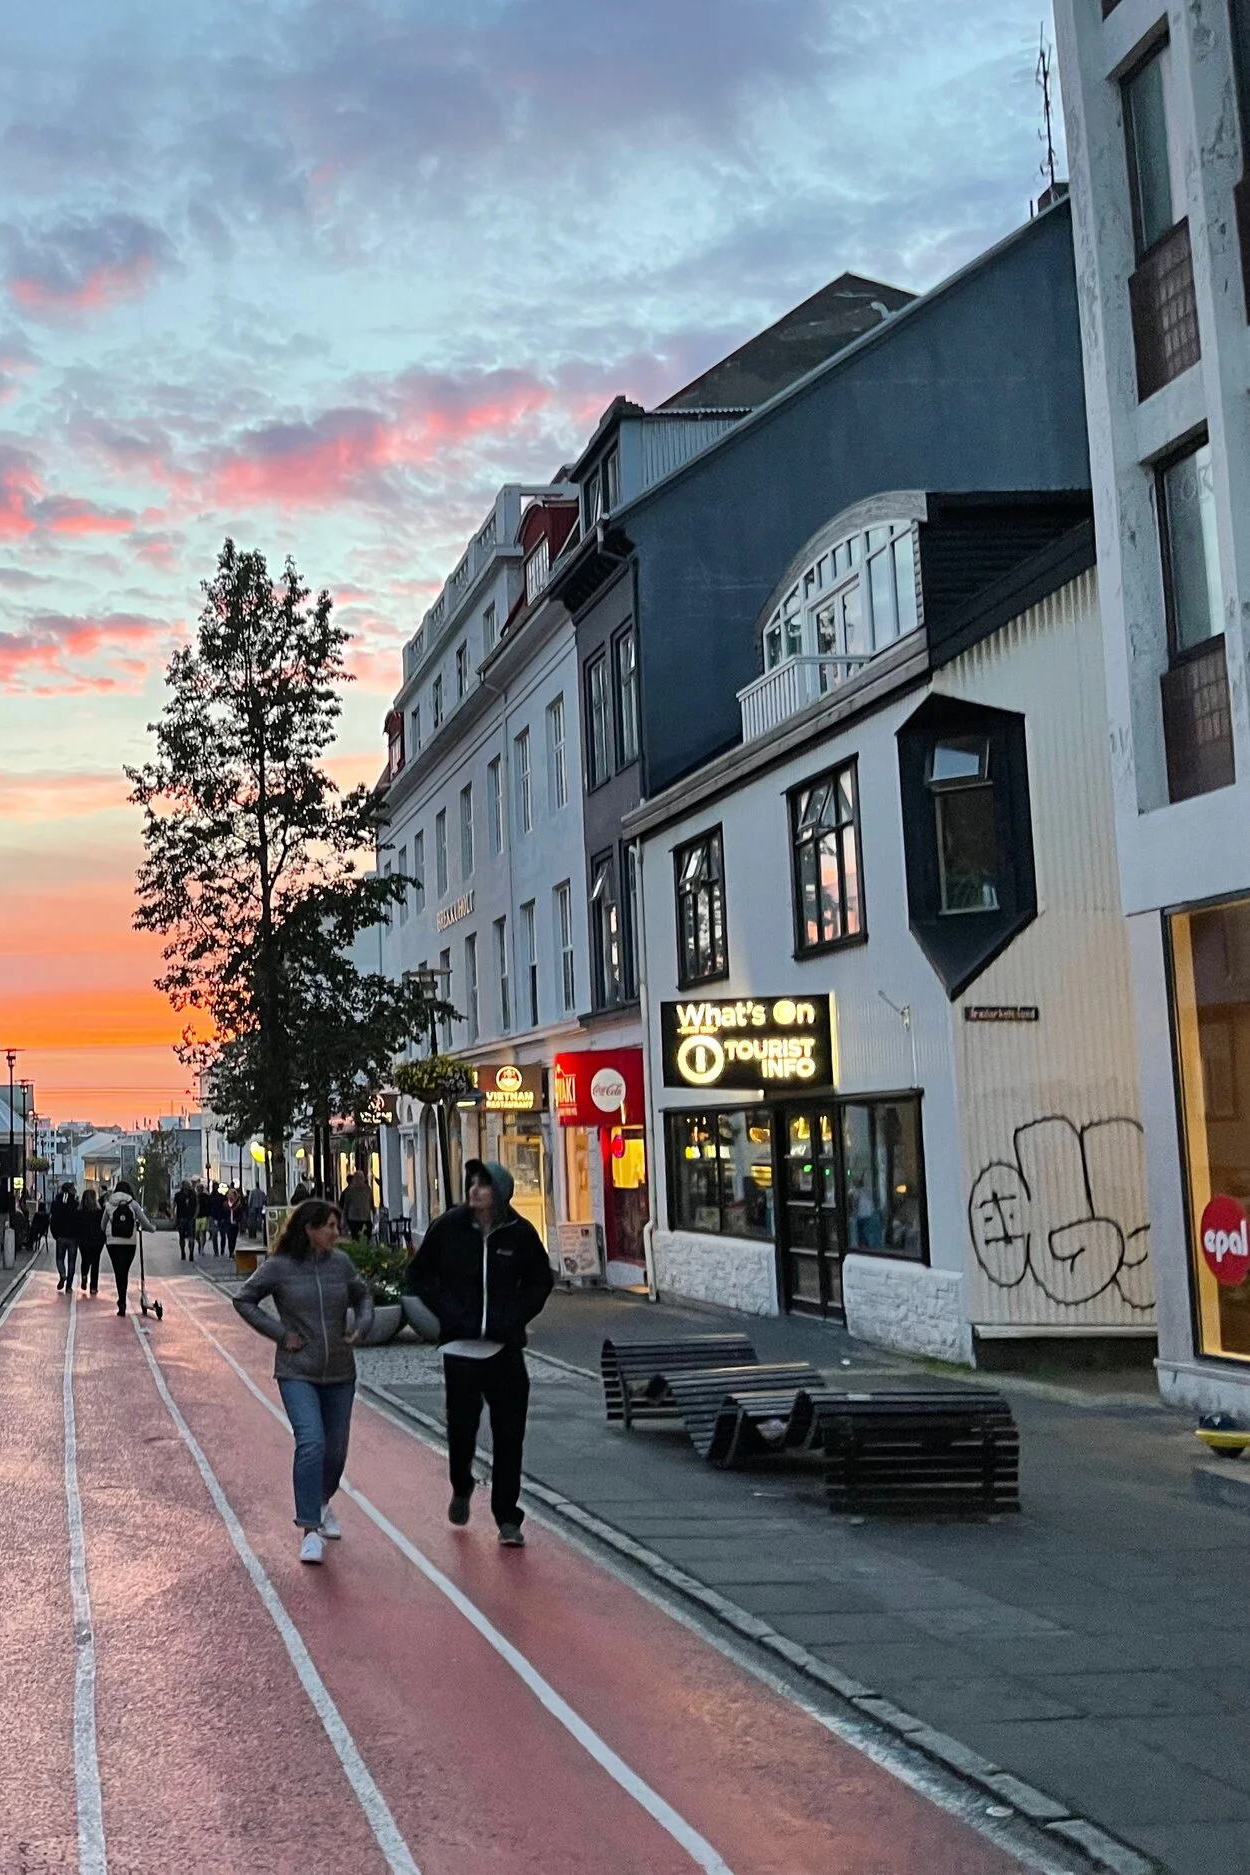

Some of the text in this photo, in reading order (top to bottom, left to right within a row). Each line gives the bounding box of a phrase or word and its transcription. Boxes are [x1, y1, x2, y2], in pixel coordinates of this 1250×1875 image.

[676, 1000, 815, 1027] What's On
[724, 1039, 816, 1060] TOURIST
[762, 1057, 816, 1078] INFO
[486, 1091, 534, 1101] VIETNAM
[486, 1100, 534, 1109] RESTAURANT
[1204, 1220, 1249, 1263] epal
